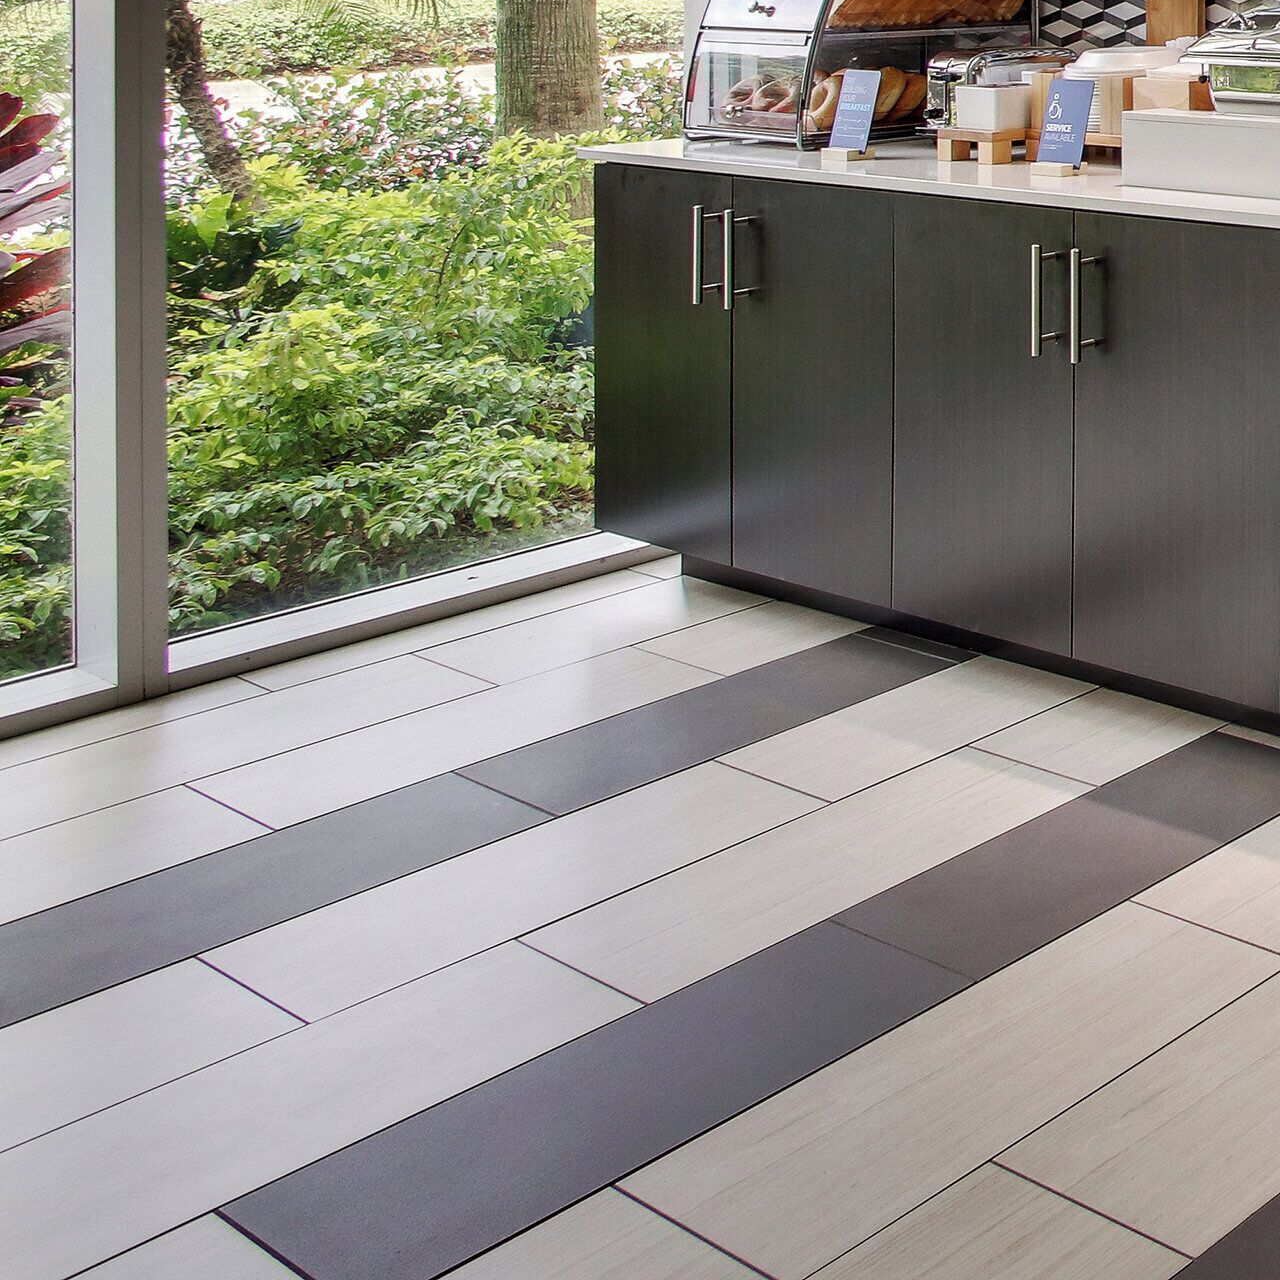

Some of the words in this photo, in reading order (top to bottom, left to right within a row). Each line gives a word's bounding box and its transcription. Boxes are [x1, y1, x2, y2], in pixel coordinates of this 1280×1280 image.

[840, 102, 871, 112] BREAKFAST
[1045, 123, 1073, 133] SERVICE
[1043, 132, 1076, 143] AVAILABLE
